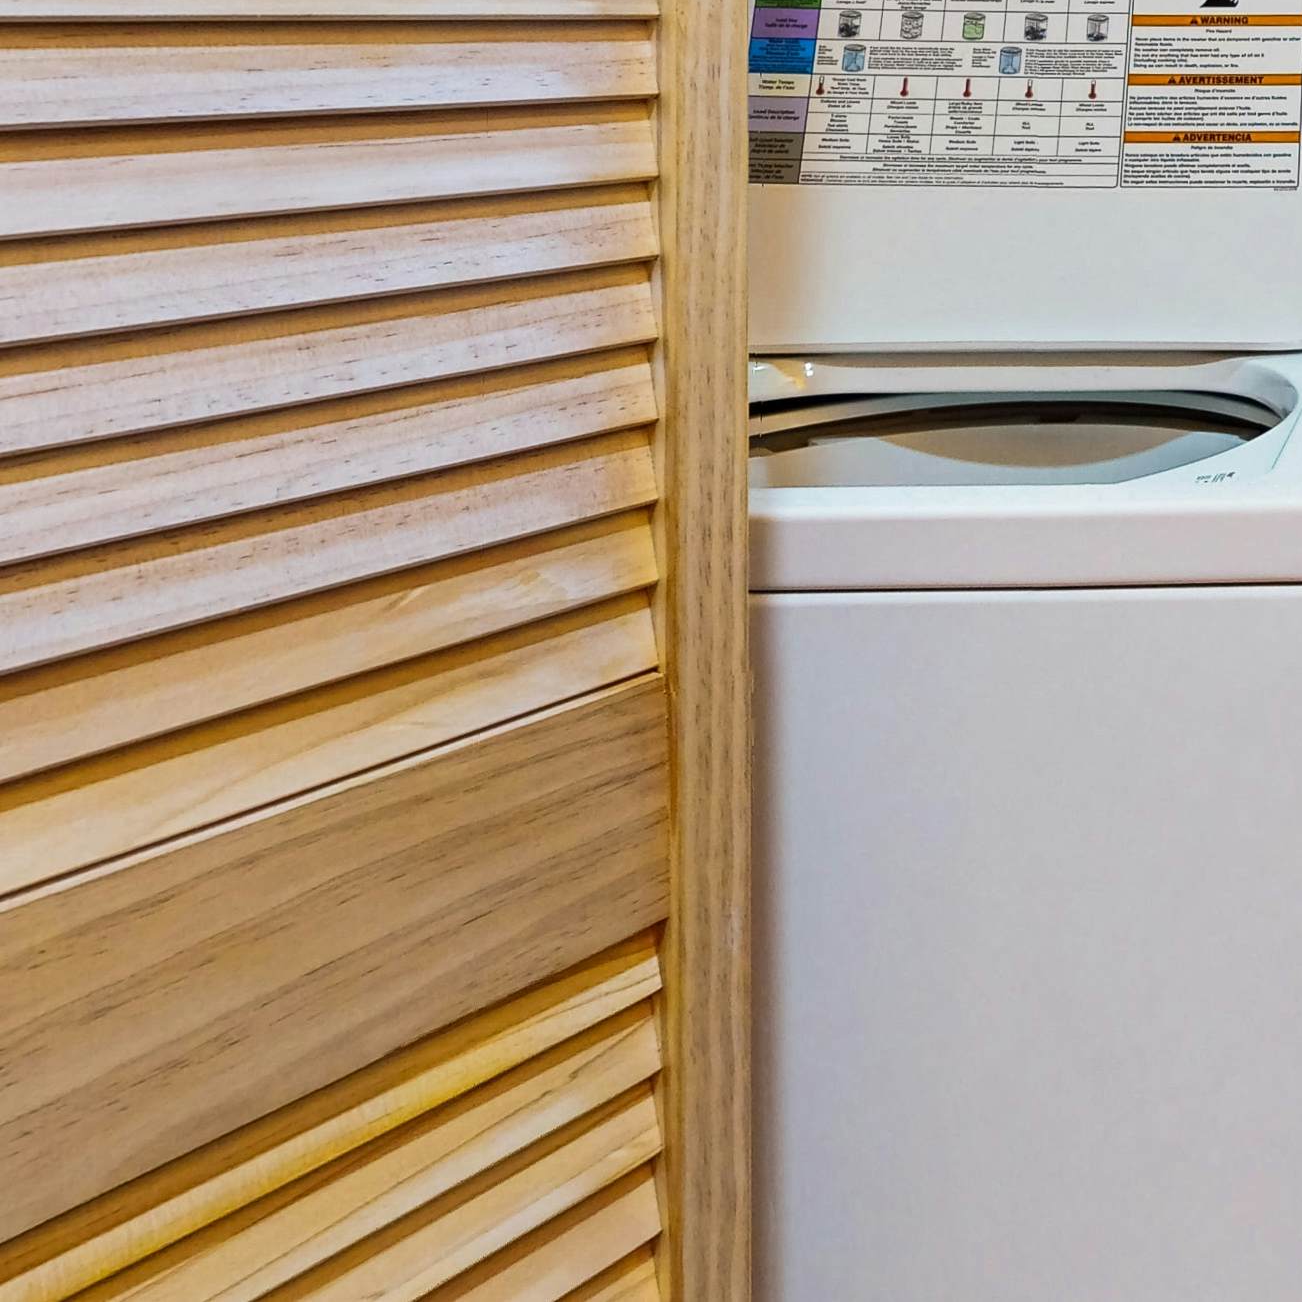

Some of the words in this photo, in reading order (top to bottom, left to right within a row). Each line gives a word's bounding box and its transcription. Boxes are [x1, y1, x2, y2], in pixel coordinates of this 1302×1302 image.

[1200, 16, 1249, 25] WARNING
[1178, 75, 1264, 85] AVERTISSEMENT
[1183, 133, 1253, 142] ADVERTENCIA
